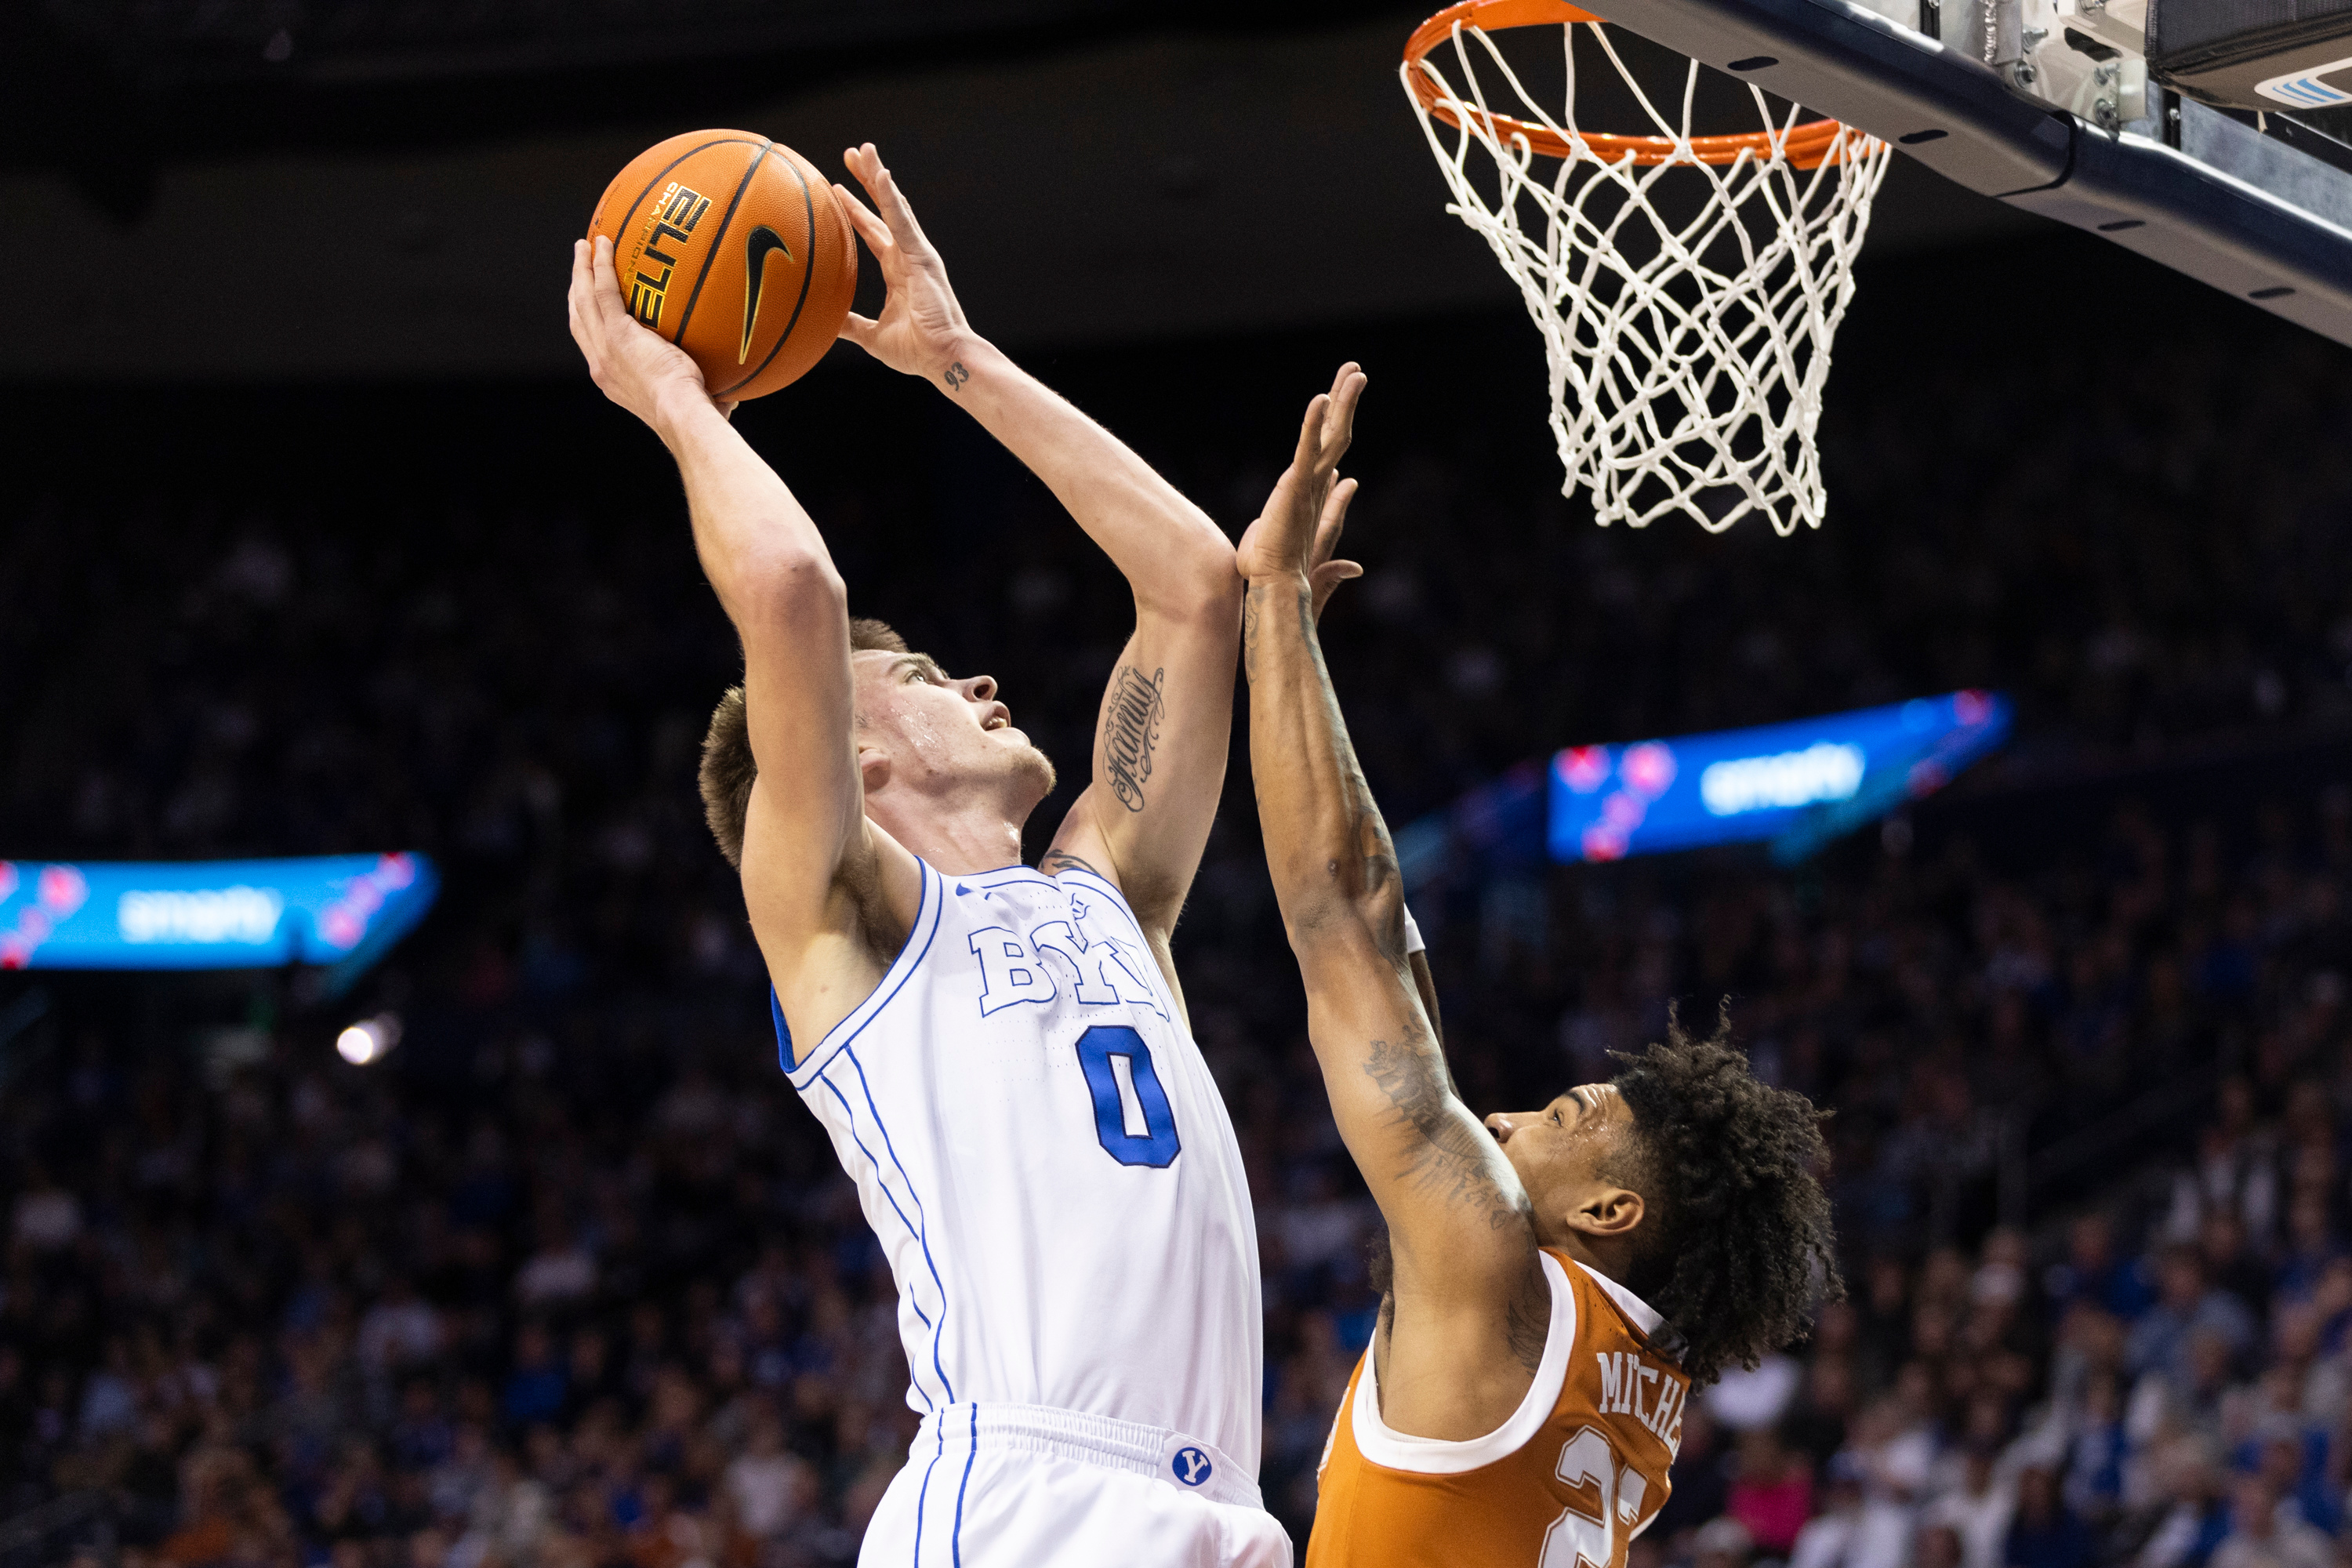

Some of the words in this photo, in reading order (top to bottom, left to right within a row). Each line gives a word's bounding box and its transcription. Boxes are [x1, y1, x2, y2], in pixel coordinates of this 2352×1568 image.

[628, 185, 713, 330] ELITE
[944, 361, 969, 392] 93
[1103, 666, 1165, 813] Family
[1075, 1025, 1182, 1169] 0
[1181, 1450, 1208, 1483] Y
